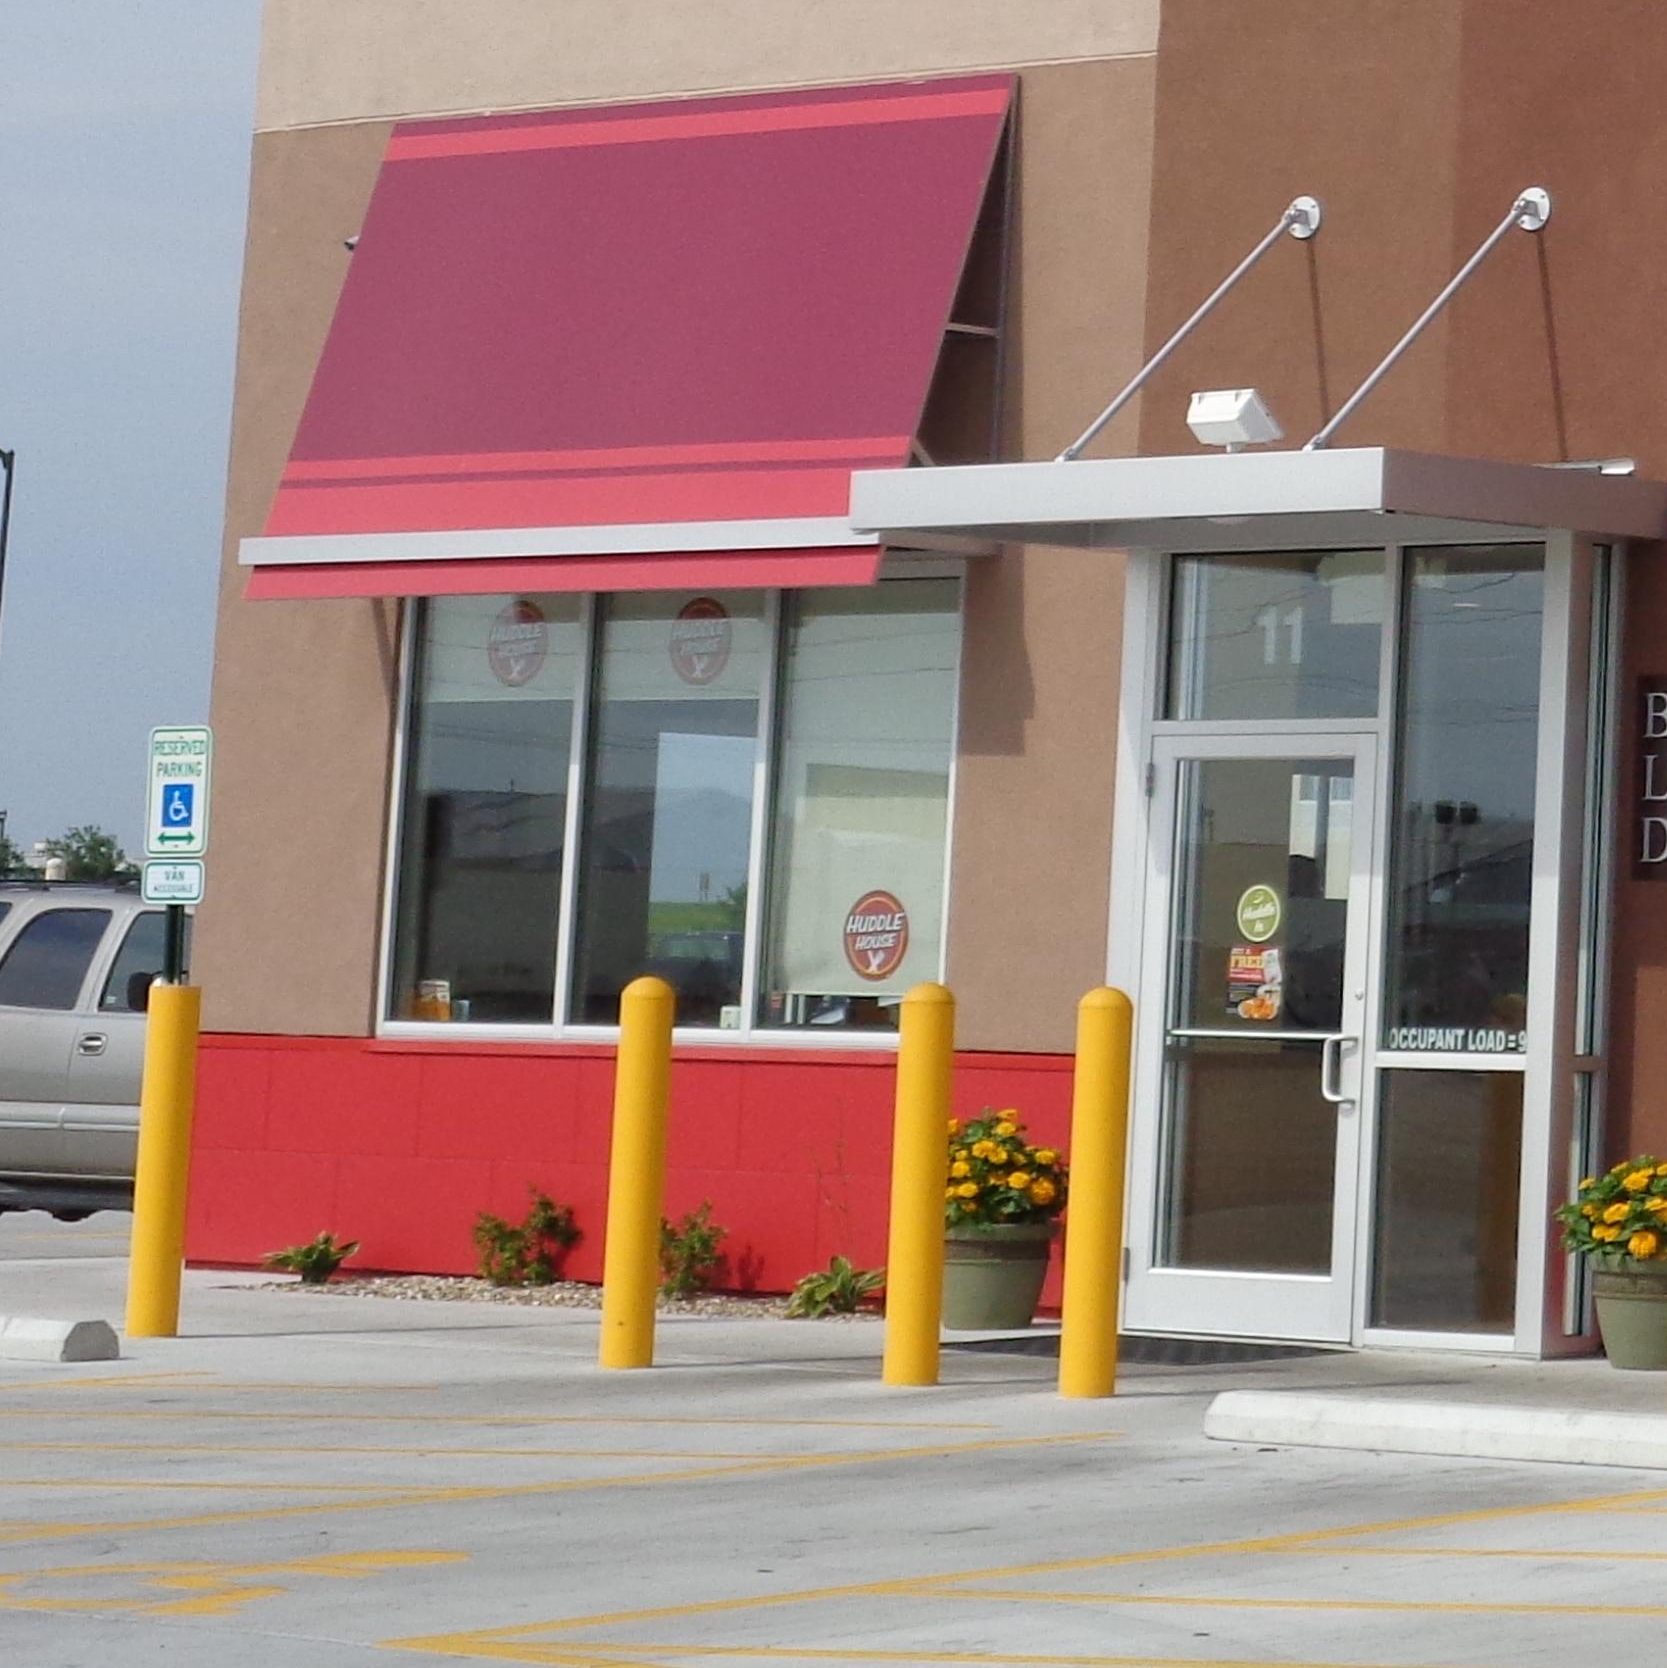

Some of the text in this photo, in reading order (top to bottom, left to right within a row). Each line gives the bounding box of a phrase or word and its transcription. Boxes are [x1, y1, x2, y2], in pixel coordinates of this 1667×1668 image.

[153, 740, 206, 755] RESERVED
[156, 761, 202, 777] PARKING
[164, 870, 186, 881] VAN
[846, 912, 905, 934] HUDDLE
[855, 933, 897, 950] HOUSE
[1389, 1027, 1465, 1050] OCCUPANT
